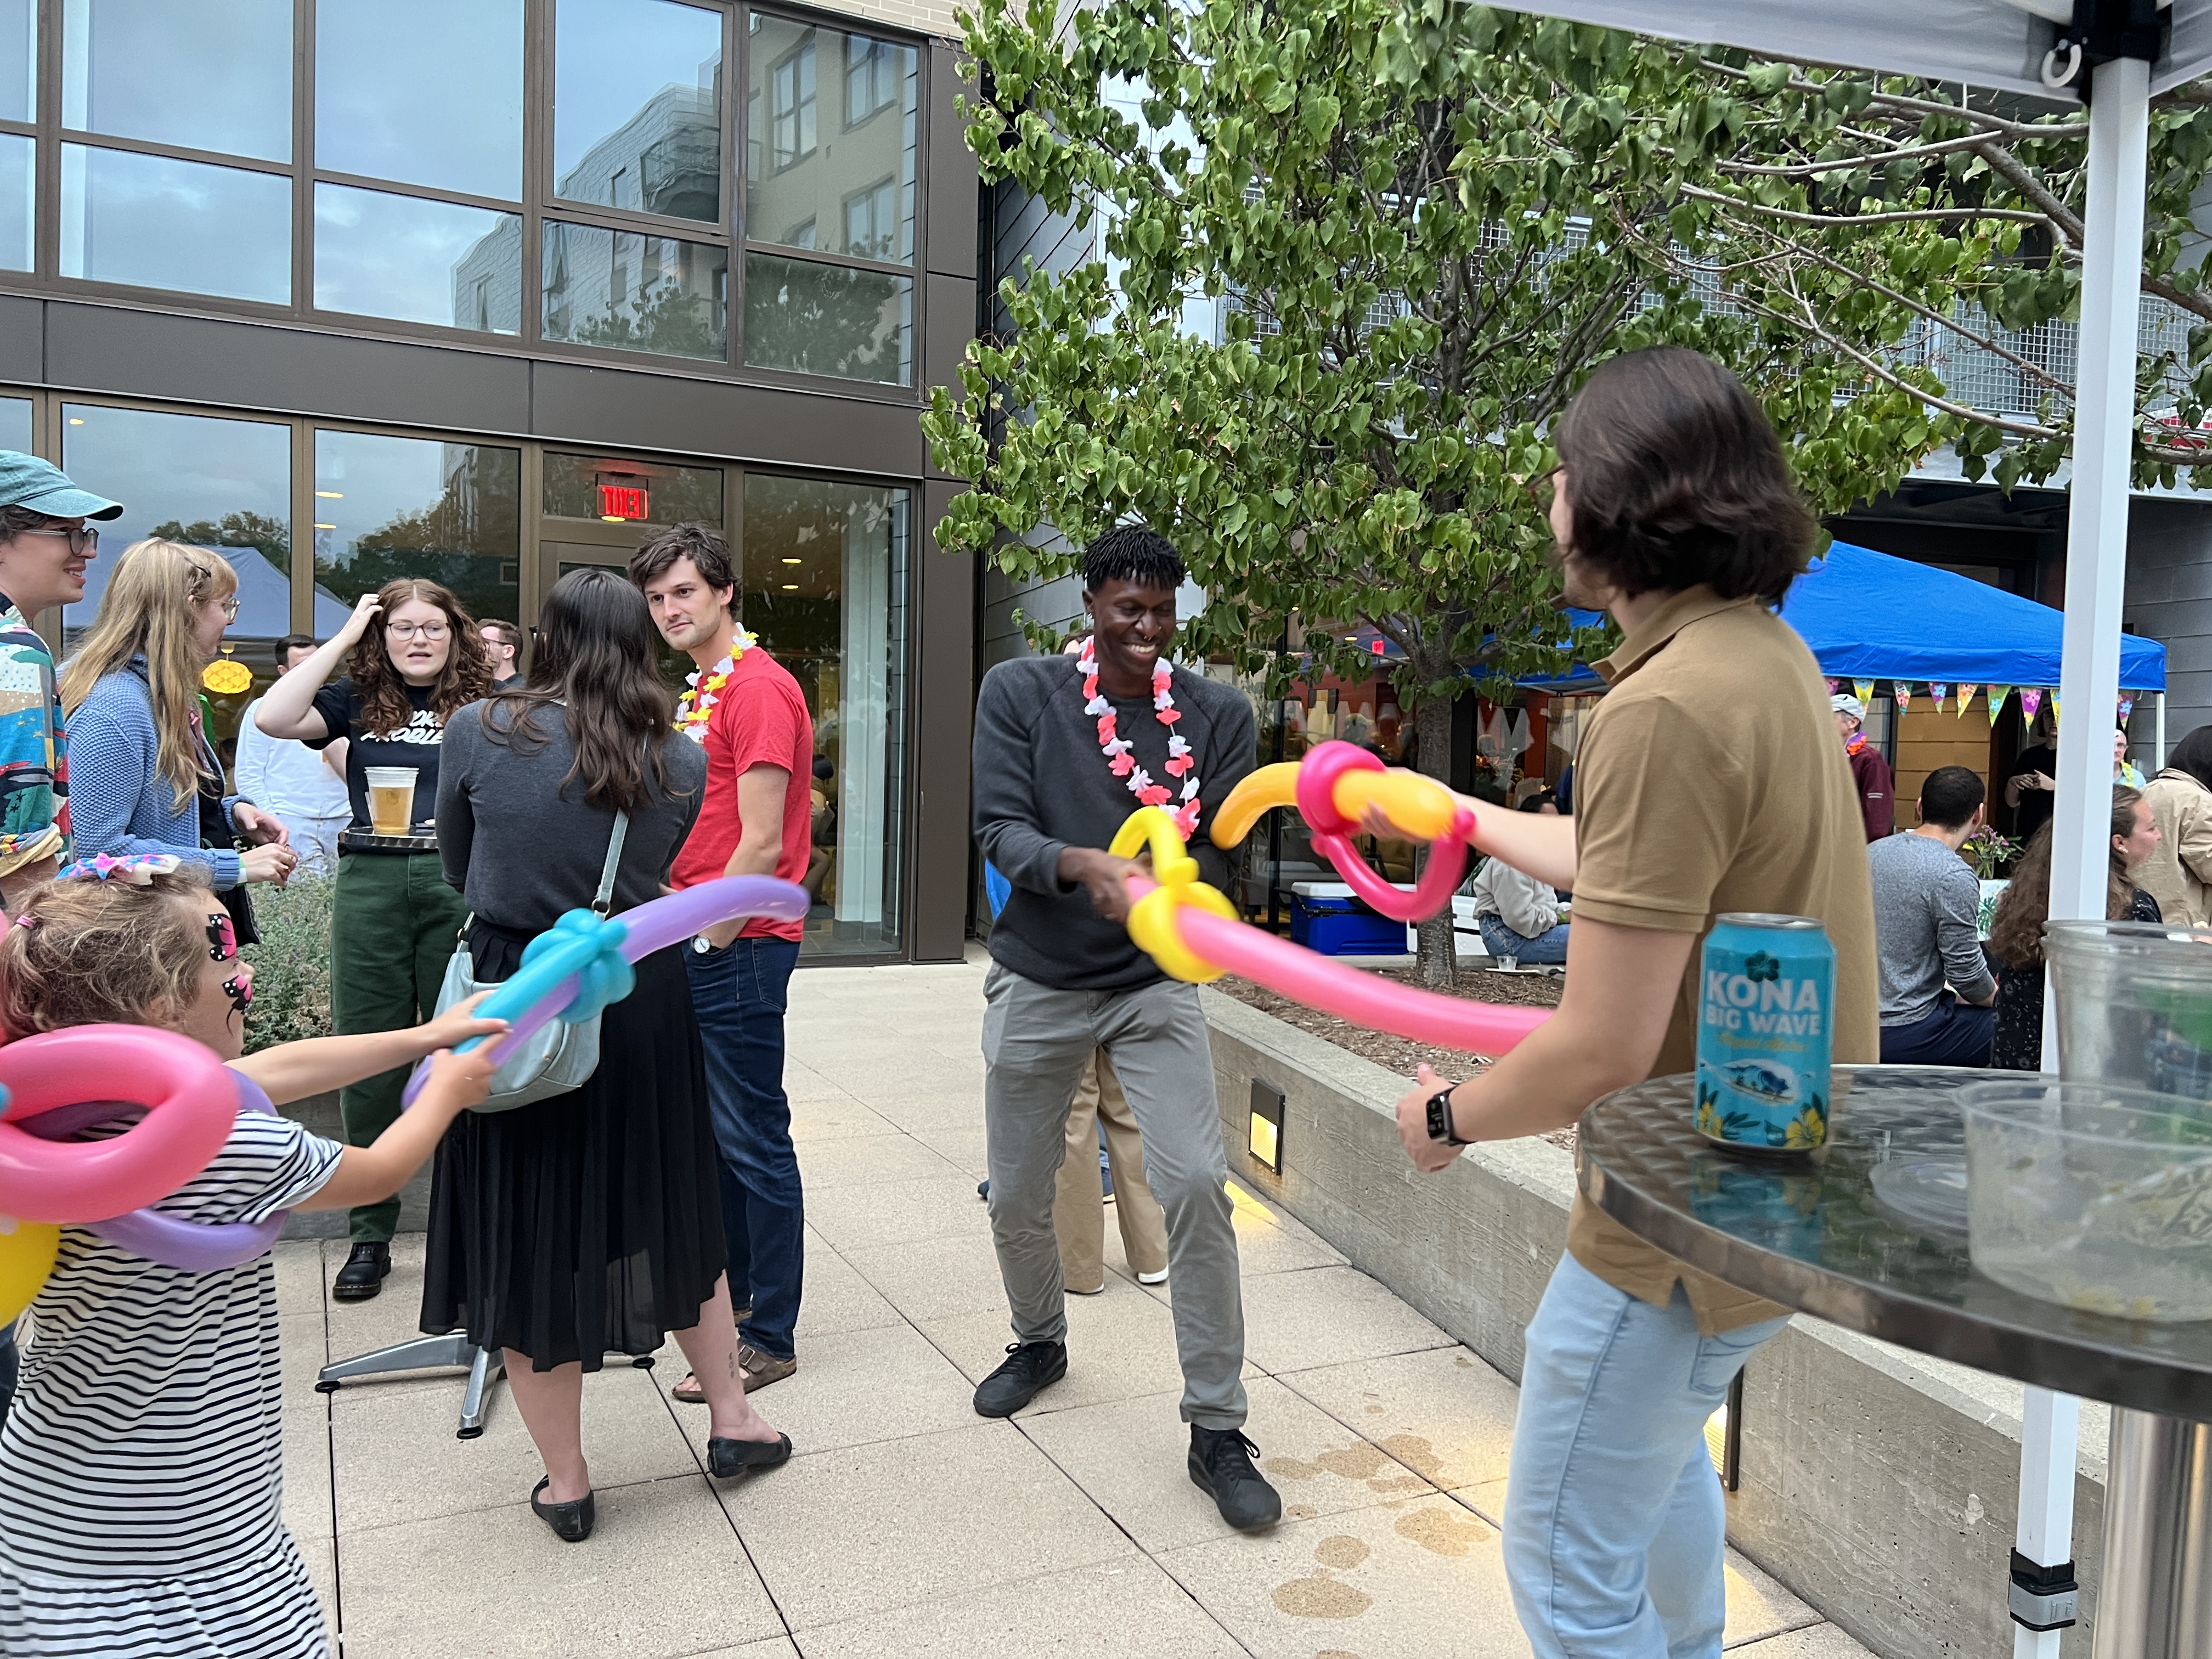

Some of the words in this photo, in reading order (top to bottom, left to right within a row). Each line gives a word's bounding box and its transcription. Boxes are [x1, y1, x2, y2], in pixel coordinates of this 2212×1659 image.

[1707, 970, 1819, 1012] KONA
[1706, 1005, 1741, 1029] BIG
[1747, 1011, 1820, 1035] WAVE
